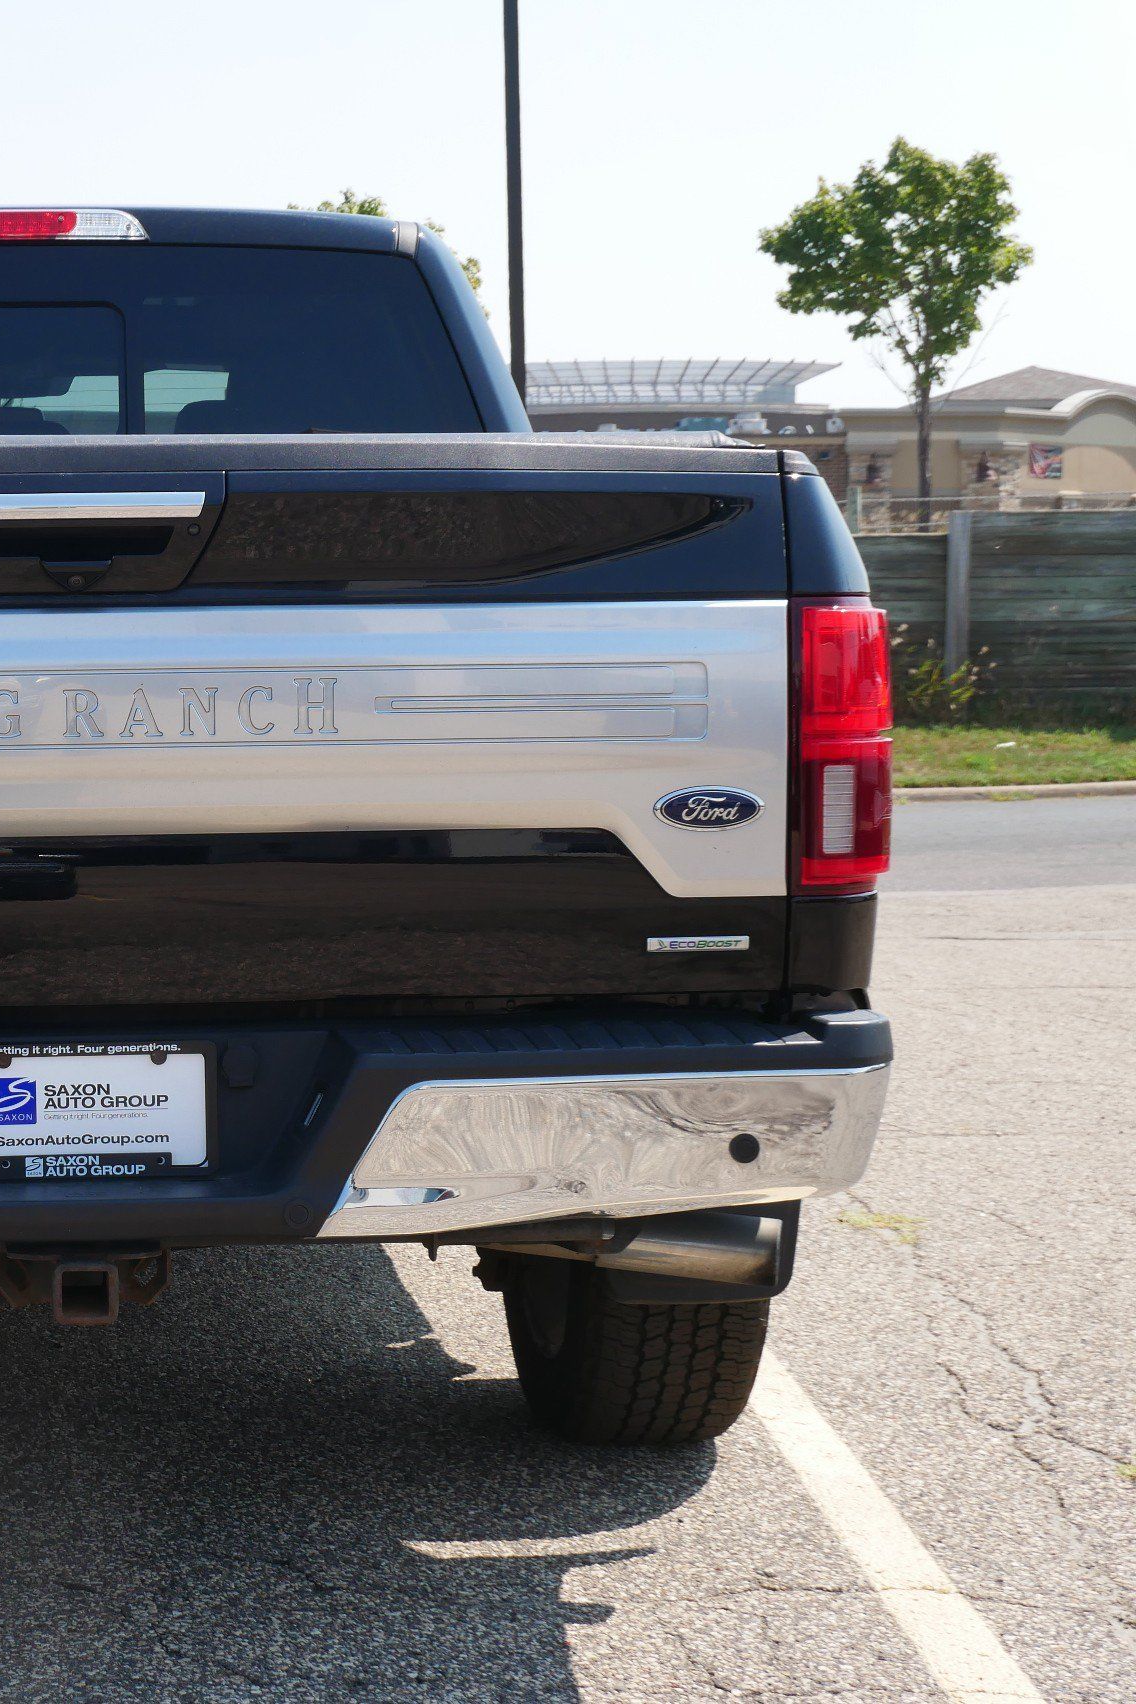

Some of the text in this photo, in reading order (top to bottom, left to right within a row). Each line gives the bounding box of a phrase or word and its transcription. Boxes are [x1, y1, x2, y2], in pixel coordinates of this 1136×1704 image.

[62, 678, 339, 738] RANCH
[682, 797, 740, 821] Ford
[32, 1046, 39, 1054] it
[43, 1045, 73, 1054] right.
[78, 1045, 104, 1053] Four
[108, 1043, 181, 1053] generations.
[44, 1084, 110, 1096] SAXON
[44, 1095, 168, 1109] AUTO GROUP
[46, 1156, 100, 1166] SAXON
[46, 1167, 89, 1176] AUTO
[93, 1165, 146, 1175] GROUP
